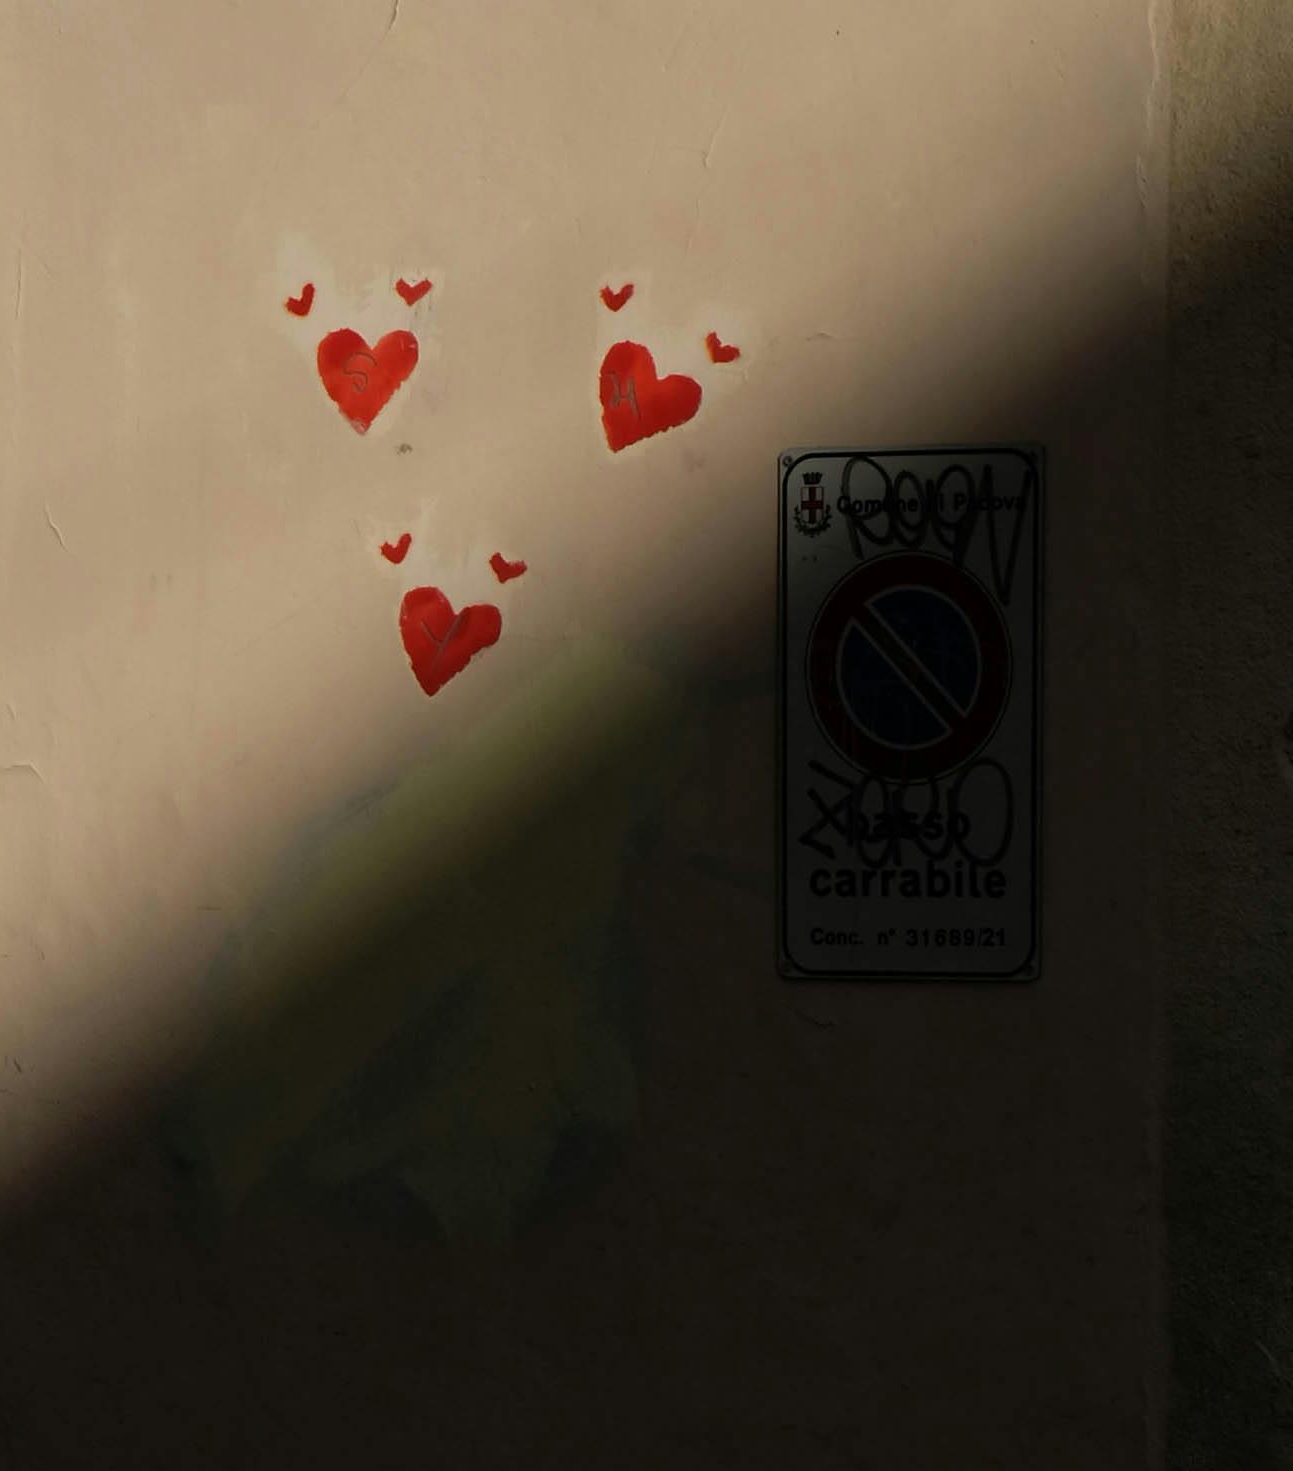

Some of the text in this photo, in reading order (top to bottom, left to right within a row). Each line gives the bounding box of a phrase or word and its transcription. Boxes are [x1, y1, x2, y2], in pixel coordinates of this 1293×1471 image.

[837, 495, 919, 513] Comne
[810, 860, 1007, 898] carrabile
[810, 928, 864, 946] Conc.
